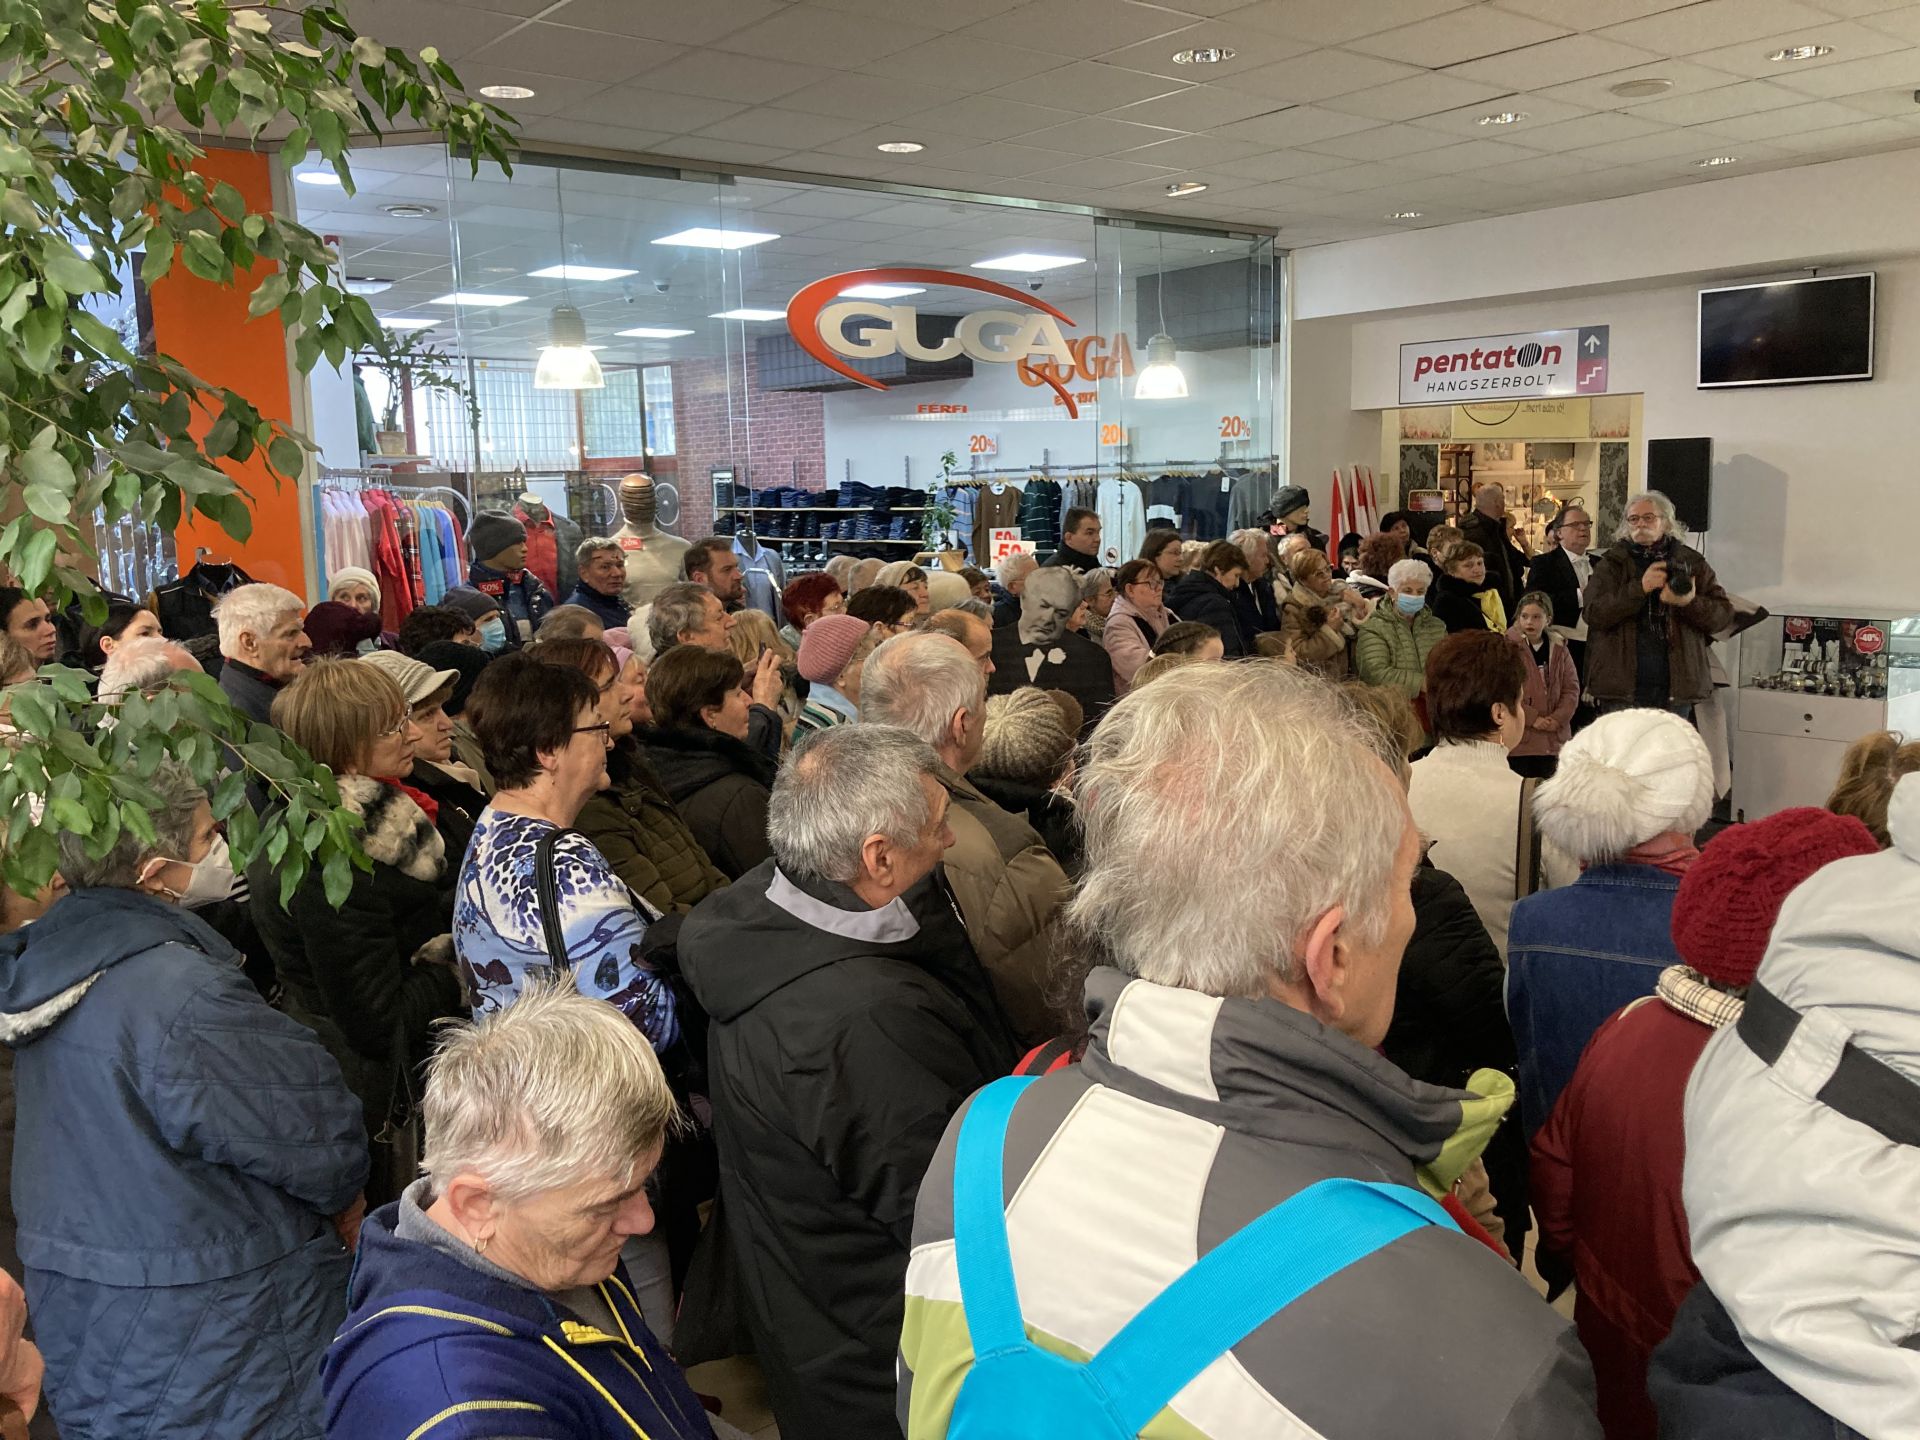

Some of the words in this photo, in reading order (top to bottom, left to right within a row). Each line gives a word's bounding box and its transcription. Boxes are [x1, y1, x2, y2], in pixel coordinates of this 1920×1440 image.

[817, 301, 1077, 365] GUGA
[1413, 342, 1562, 382] pentaton
[1426, 373, 1556, 393] HANGSZERBOLT
[917, 401, 968, 413] FÉRFI
[1217, 415, 1251, 438] -20%
[967, 434, 996, 453] -20%
[481, 583, 499, 593] 50%
